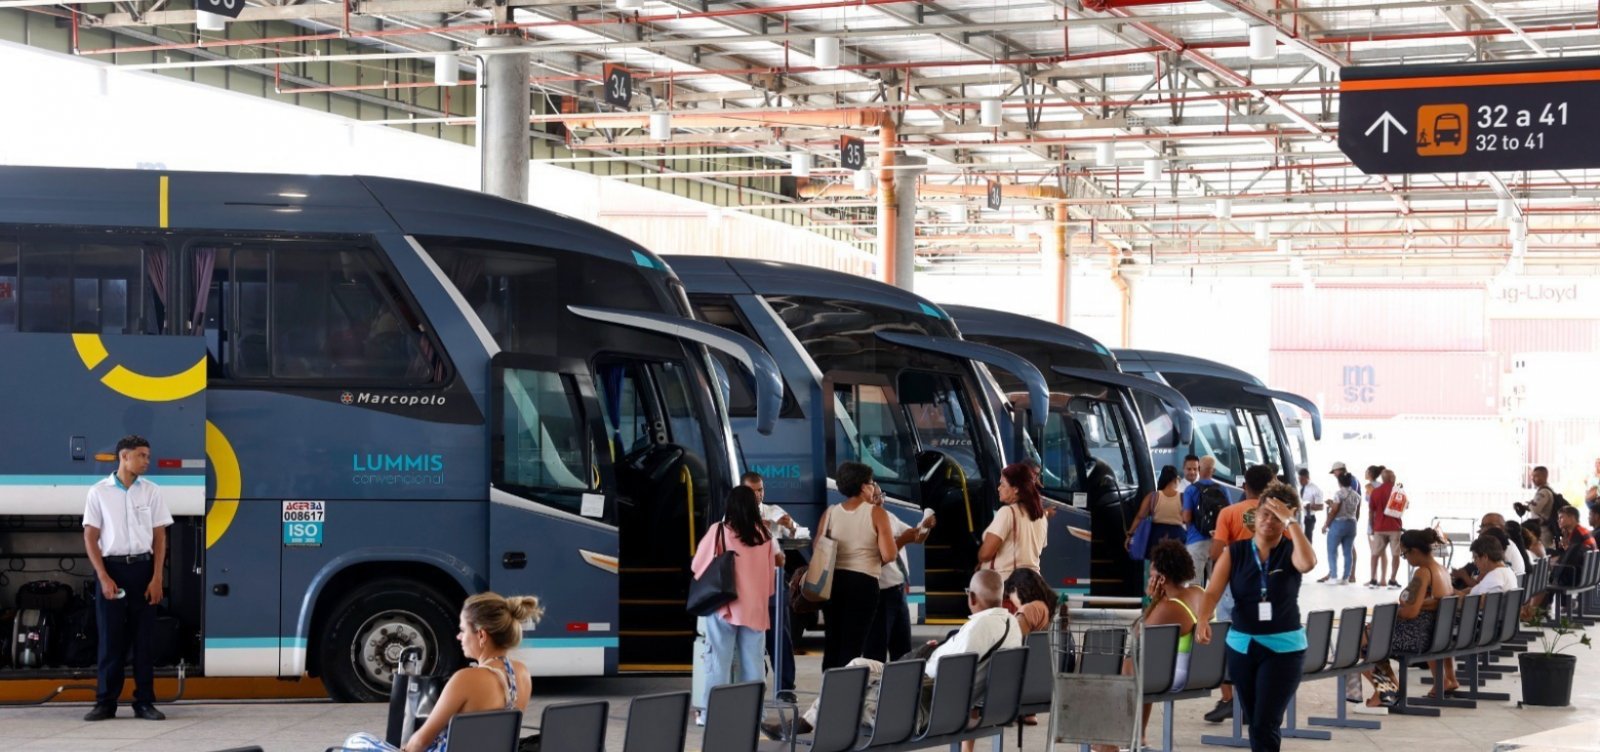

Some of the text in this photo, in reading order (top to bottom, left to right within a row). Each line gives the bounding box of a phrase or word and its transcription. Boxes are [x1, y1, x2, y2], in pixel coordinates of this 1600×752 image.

[611, 73, 628, 101] 34
[1477, 102, 1568, 129] 32 a 41
[1475, 132, 1544, 151] 32 to 41
[847, 143, 861, 165] 35
[991, 187, 1000, 206] 36
[357, 392, 446, 406] Marcopolo
[940, 438, 972, 446] Marco
[353, 454, 443, 471] LUMMIS
[352, 472, 444, 485] convencional
[284, 511, 323, 521] 008617
[289, 523, 318, 537] ISO
